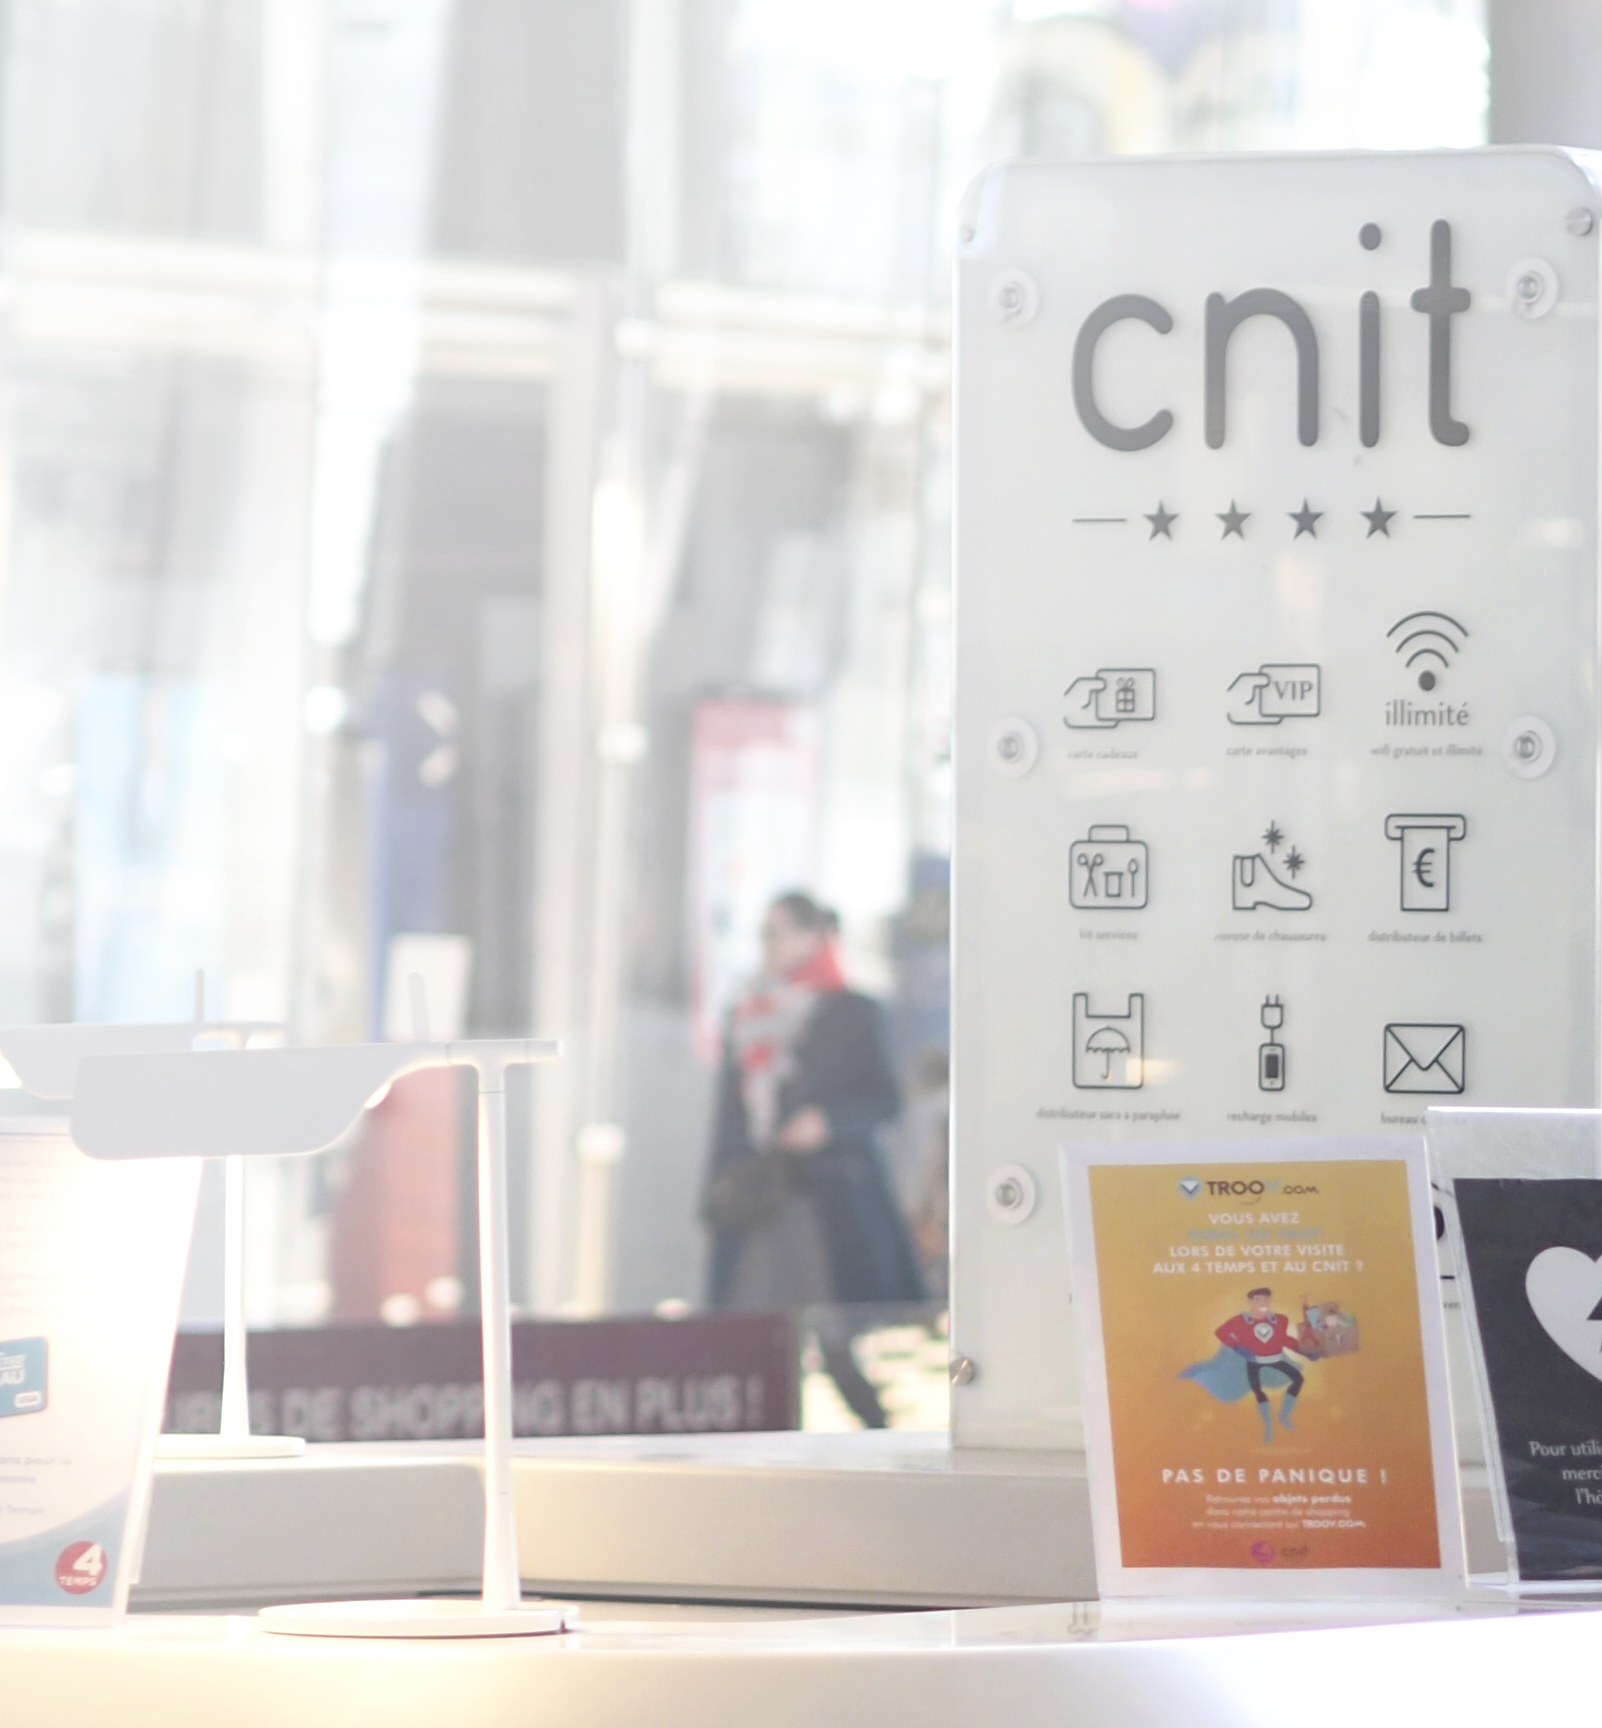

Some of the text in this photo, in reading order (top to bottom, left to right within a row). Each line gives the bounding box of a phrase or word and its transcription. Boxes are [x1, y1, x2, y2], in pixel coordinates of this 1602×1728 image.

[1071, 217, 1471, 452] cnit
[1272, 680, 1314, 703] VIP
[1384, 699, 1471, 727] illimité
[1256, 745, 1308, 760] avantages
[1393, 745, 1430, 760] gratuit
[1367, 930, 1482, 943] distributeur de billets
[1226, 1109, 1318, 1125] recharge mobiles
[1380, 1111, 1418, 1125] bureau
[1208, 1211, 1300, 1225] VOUS AVEZ
[1169, 1243, 1345, 1258] LORS DE VOTRE VISITE
[1153, 1260, 1364, 1274] AUX 4 TEMPS ET AU CNIT ?
[282, 1386, 341, 1442] DE
[349, 1379, 566, 1441] SHOPPNG
[571, 1377, 632, 1436] EN
[635, 1375, 741, 1434] PLUS
[1529, 1440, 1566, 1457] Pour
[1162, 1468, 1388, 1485] PAS DE PANIQUE !
[1272, 1493, 1309, 1506] objets
[1310, 1494, 1352, 1506] perdus
[72, 1543, 103, 1577] 4
[59, 1574, 98, 1588] TEMPS
